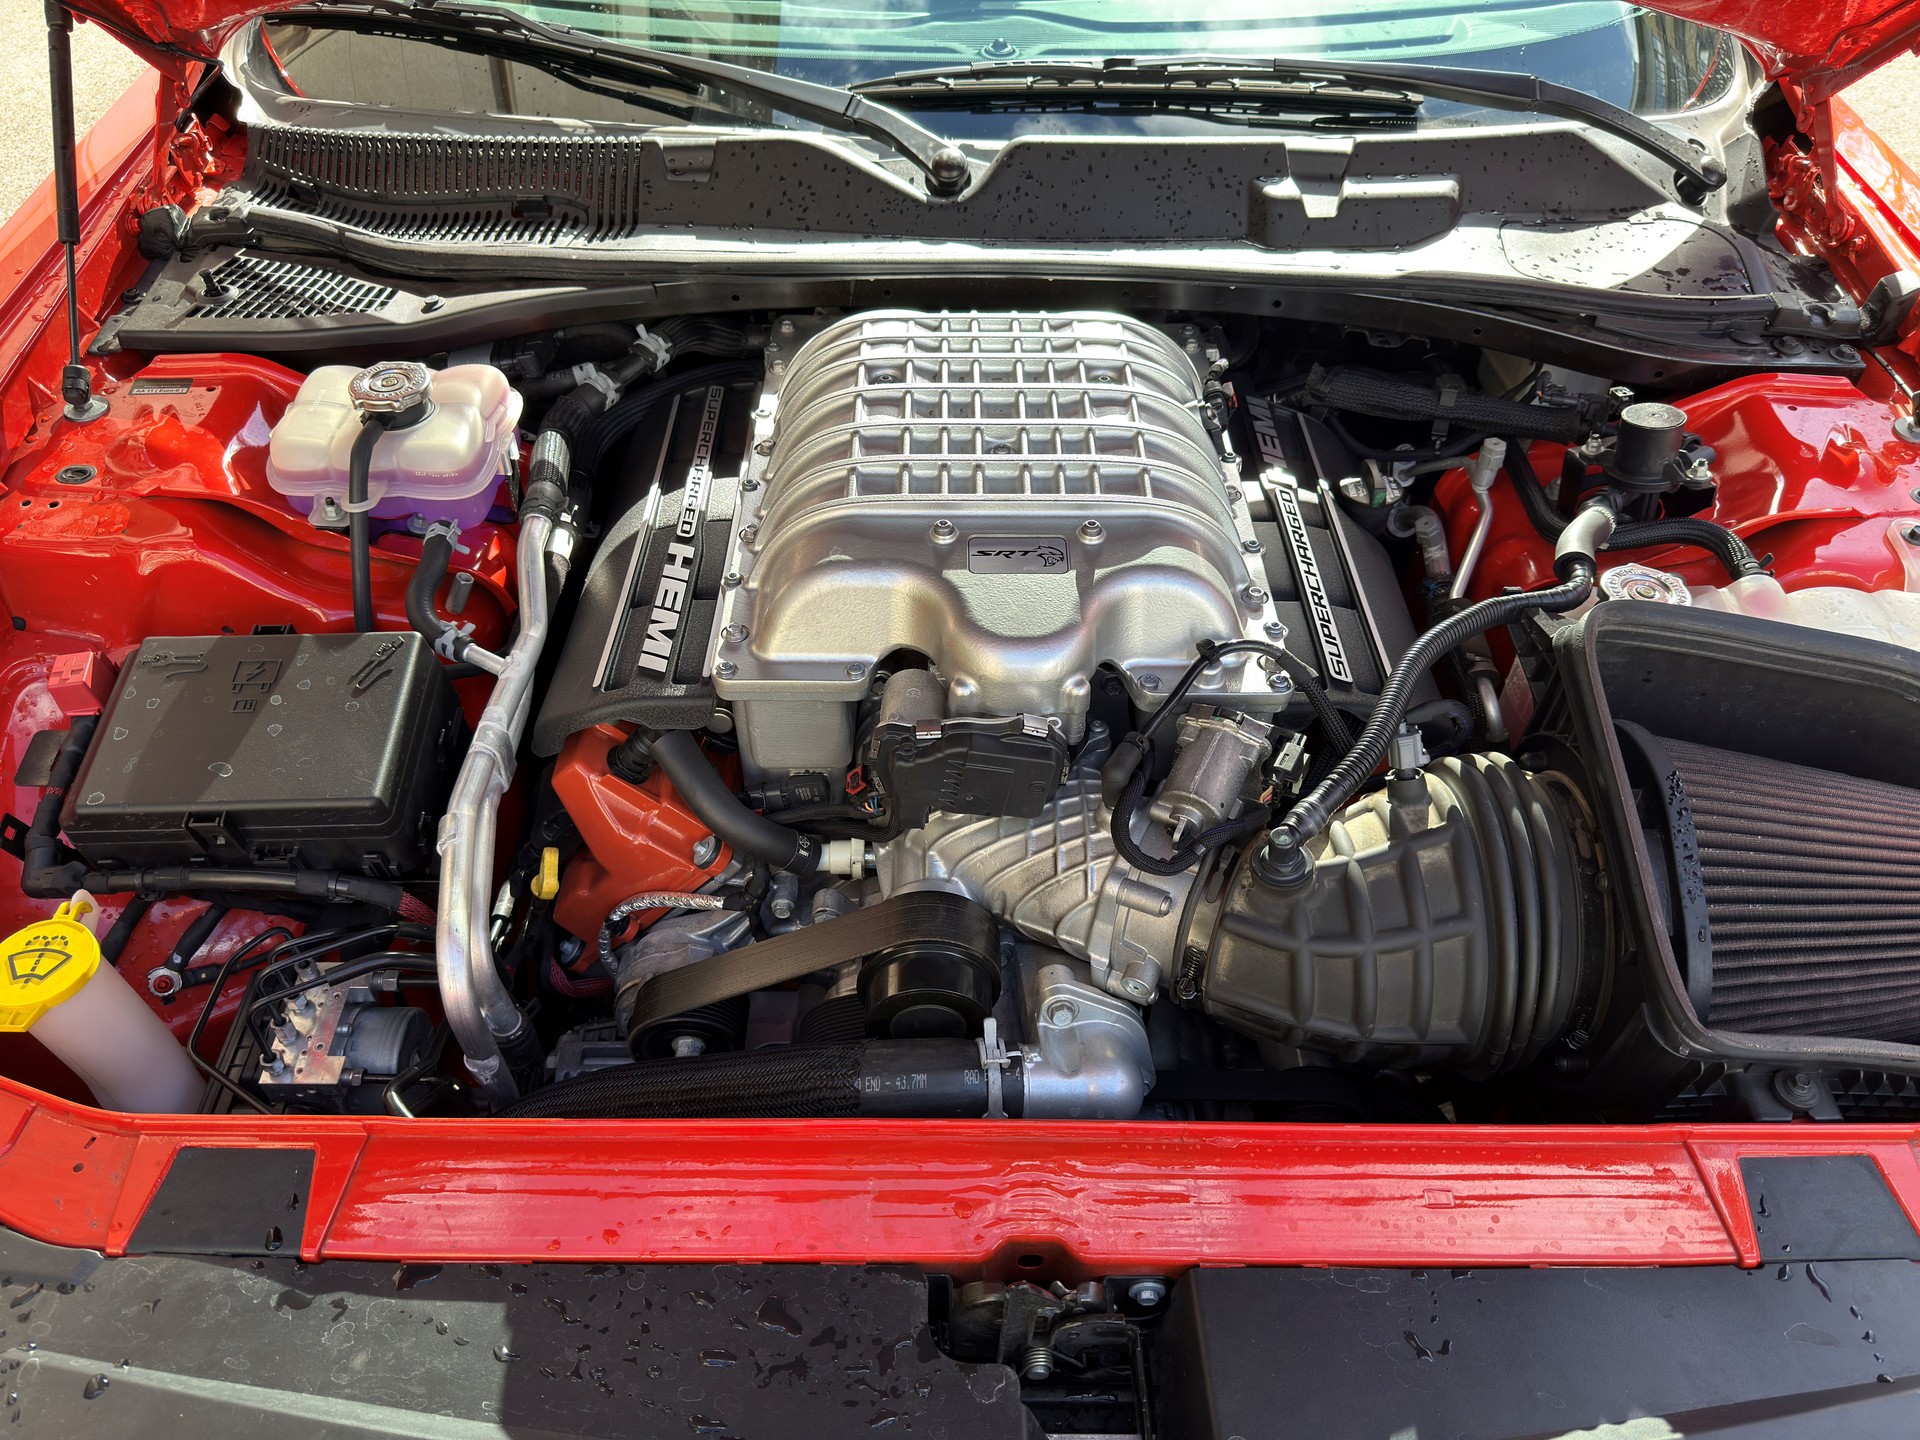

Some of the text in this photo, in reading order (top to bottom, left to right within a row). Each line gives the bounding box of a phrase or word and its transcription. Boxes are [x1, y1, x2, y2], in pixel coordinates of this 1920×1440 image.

[638, 387, 722, 673] SUPERCHARGED HEMI
[1246, 396, 1349, 683] SUPERCHARGED HEMI
[971, 550, 1038, 559] SRT
[865, 1076, 881, 1092] END
[895, 1073, 928, 1091] 43.7MM
[964, 1069, 980, 1085] RAD
